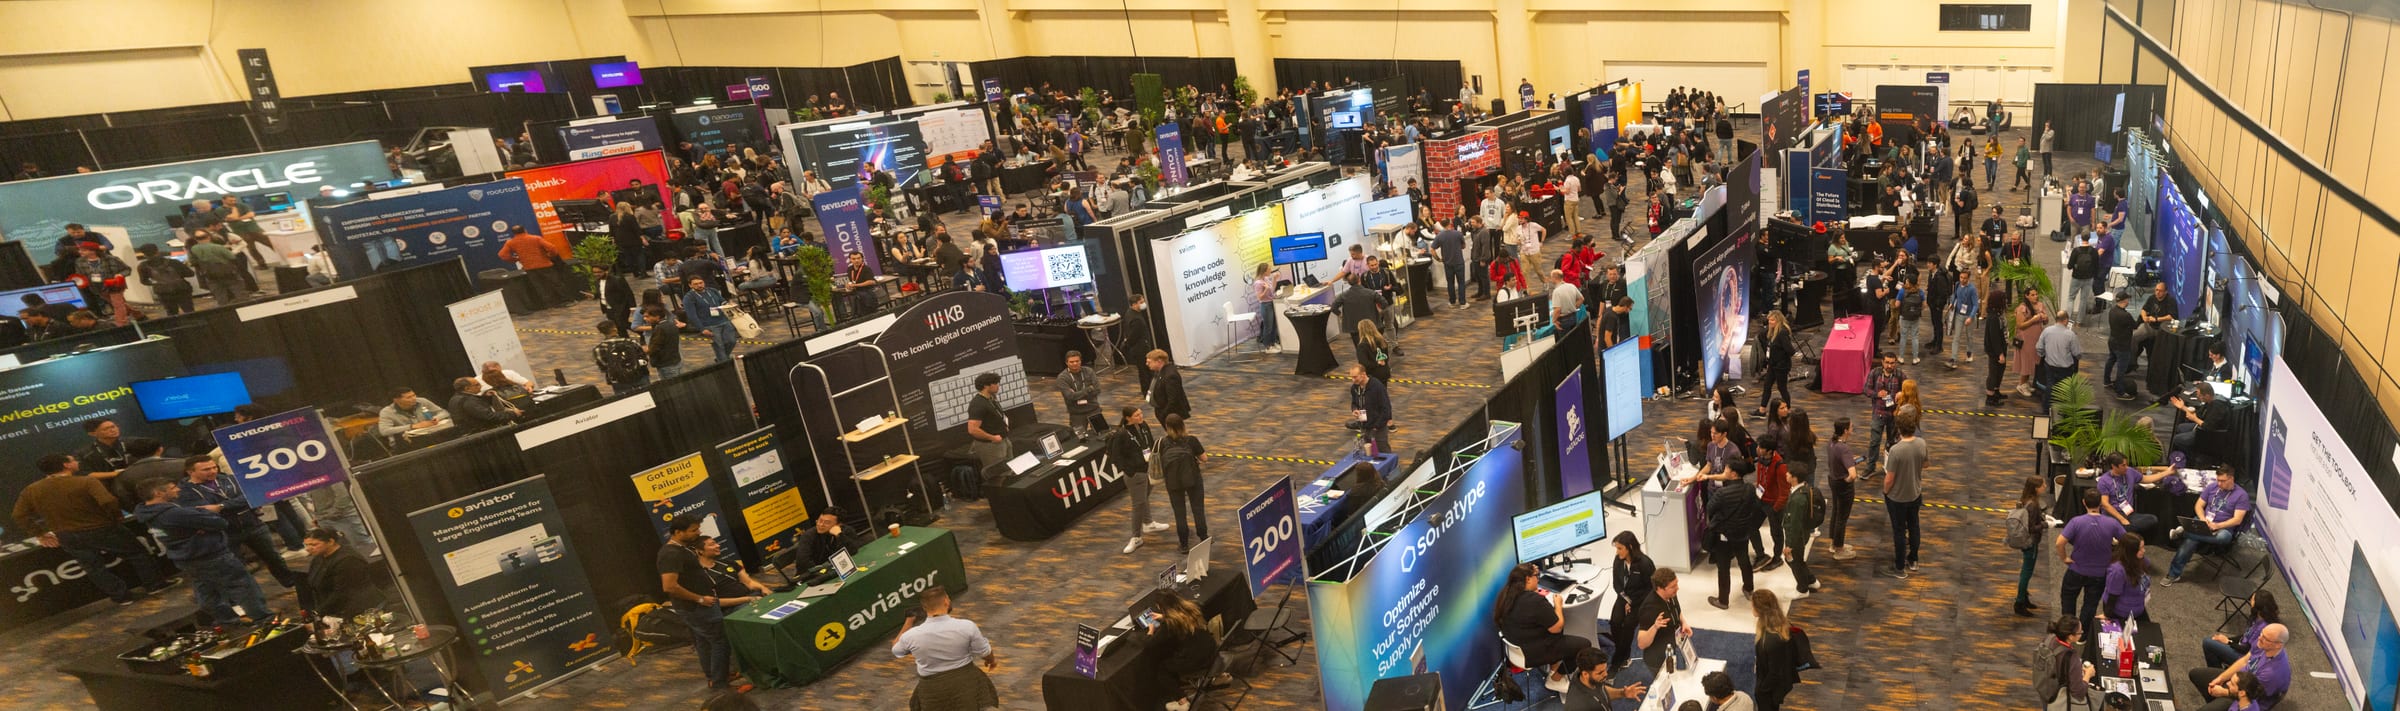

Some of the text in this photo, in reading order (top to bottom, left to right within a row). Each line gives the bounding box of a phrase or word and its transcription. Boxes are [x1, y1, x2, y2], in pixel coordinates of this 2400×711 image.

[582, 145, 635, 159] RingCentral
[87, 161, 323, 210] ORACLE
[821, 199, 858, 211] DEVELOPER
[1184, 258, 1224, 279] Share code
[1185, 270, 1226, 291] knowledge
[1187, 286, 1216, 303] without
[891, 313, 1002, 361] The Iconic Digital Companion
[8, 383, 44, 393] Database
[73, 386, 132, 406] Graph
[45, 408, 117, 429] Explainable
[725, 433, 773, 454] Monorepos don't
[755, 441, 769, 449] suck
[1566, 432, 1584, 455] DATADOG
[2312, 431, 2321, 447] GET
[2321, 444, 2331, 462] THE
[238, 440, 326, 479] 300
[646, 460, 692, 482] Got Build
[651, 471, 694, 492] Failures?
[465, 492, 516, 512] aviator
[674, 500, 706, 517] aviator
[433, 519, 479, 536] Managing
[480, 504, 528, 522] Monorepos
[437, 507, 542, 543] Large Engineering Teams
[1249, 515, 1293, 566] 200
[471, 598, 496, 611] unified
[497, 587, 528, 602] platform
[481, 589, 556, 619] Release management
[486, 591, 583, 630] Lightning-Fast Code Reviews
[848, 570, 938, 631] aviator
[1383, 578, 1426, 628] Optimize
[496, 637, 526, 650] Keeping
[527, 628, 548, 639] builds
[549, 620, 568, 631] green
[577, 611, 593, 620] scale
[514, 617, 544, 631] Stacking
[544, 613, 557, 621] PRs
[1372, 585, 1439, 660] Your Software
[1378, 604, 1440, 677] Supply Chain
